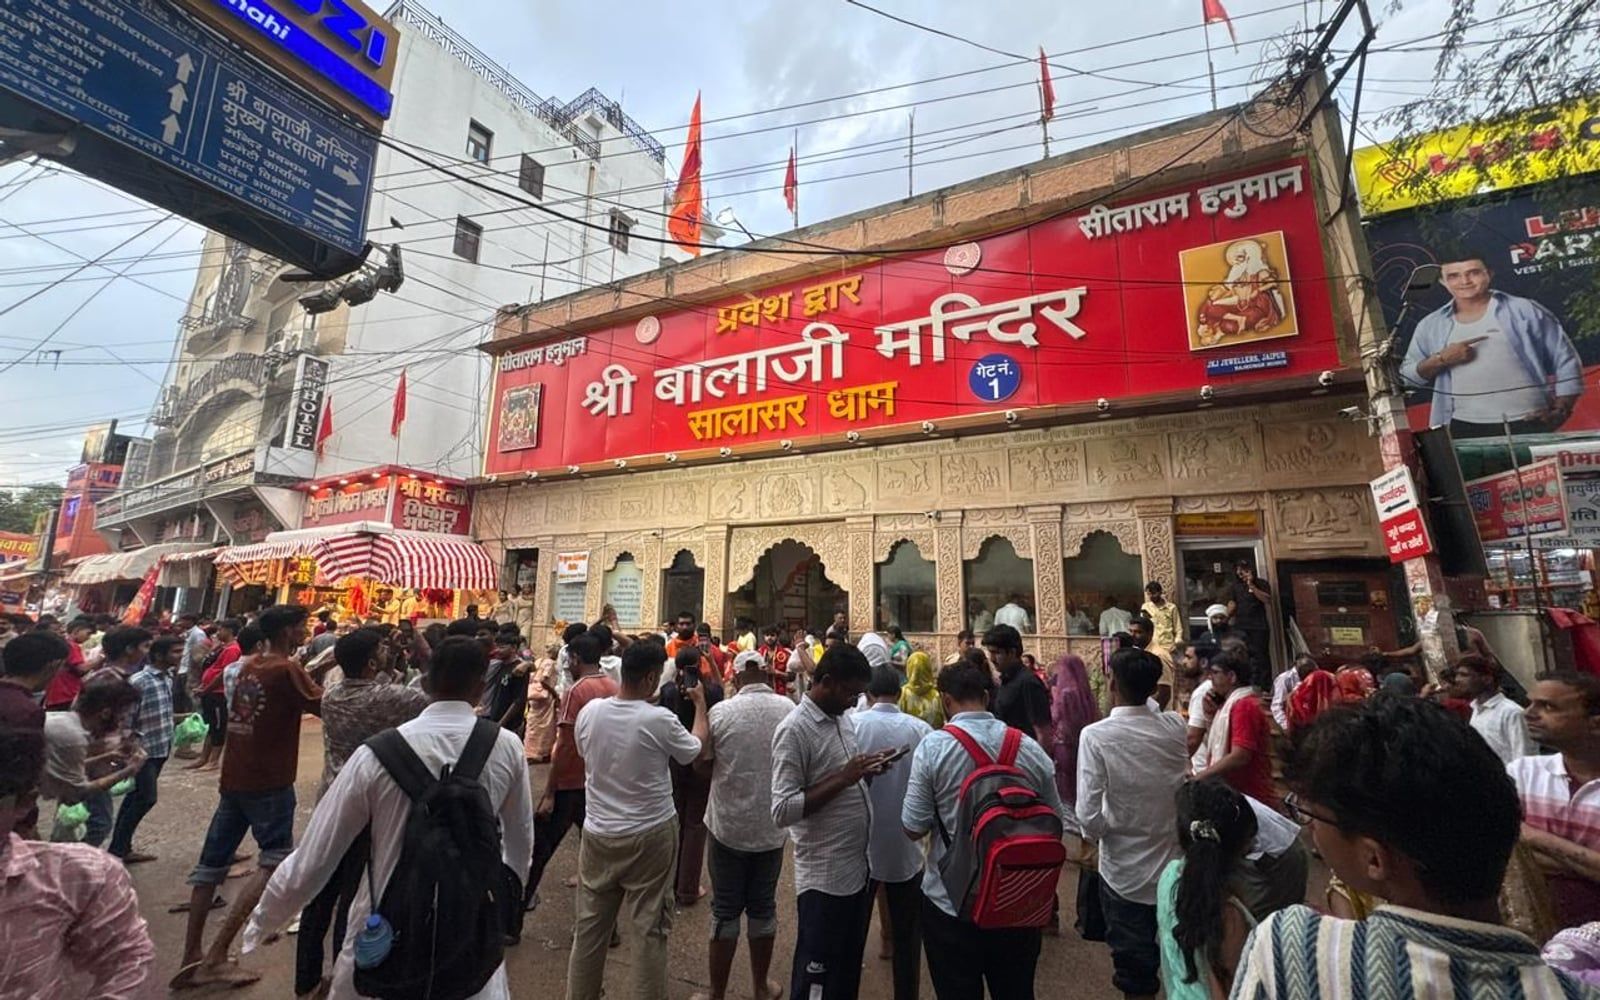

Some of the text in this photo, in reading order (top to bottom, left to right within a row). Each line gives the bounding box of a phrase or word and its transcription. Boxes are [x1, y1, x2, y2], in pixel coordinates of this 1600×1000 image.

[222, 97, 327, 169] मुख्य दरवाजा
[225, 79, 359, 170] श्री बालाजी मन्दिर
[1078, 164, 1304, 240] सीताराम हनुमान
[716, 274, 864, 334] प्रवेश द्वार
[500, 336, 588, 373] सीताराम हनुमान
[581, 286, 1088, 418] श्री बालाजी मन्दिर
[976, 363, 997, 380] गेट
[688, 380, 899, 441] सालासर धाम
[987, 379, 1000, 399] 1
[294, 391, 318, 448] HOTEL
